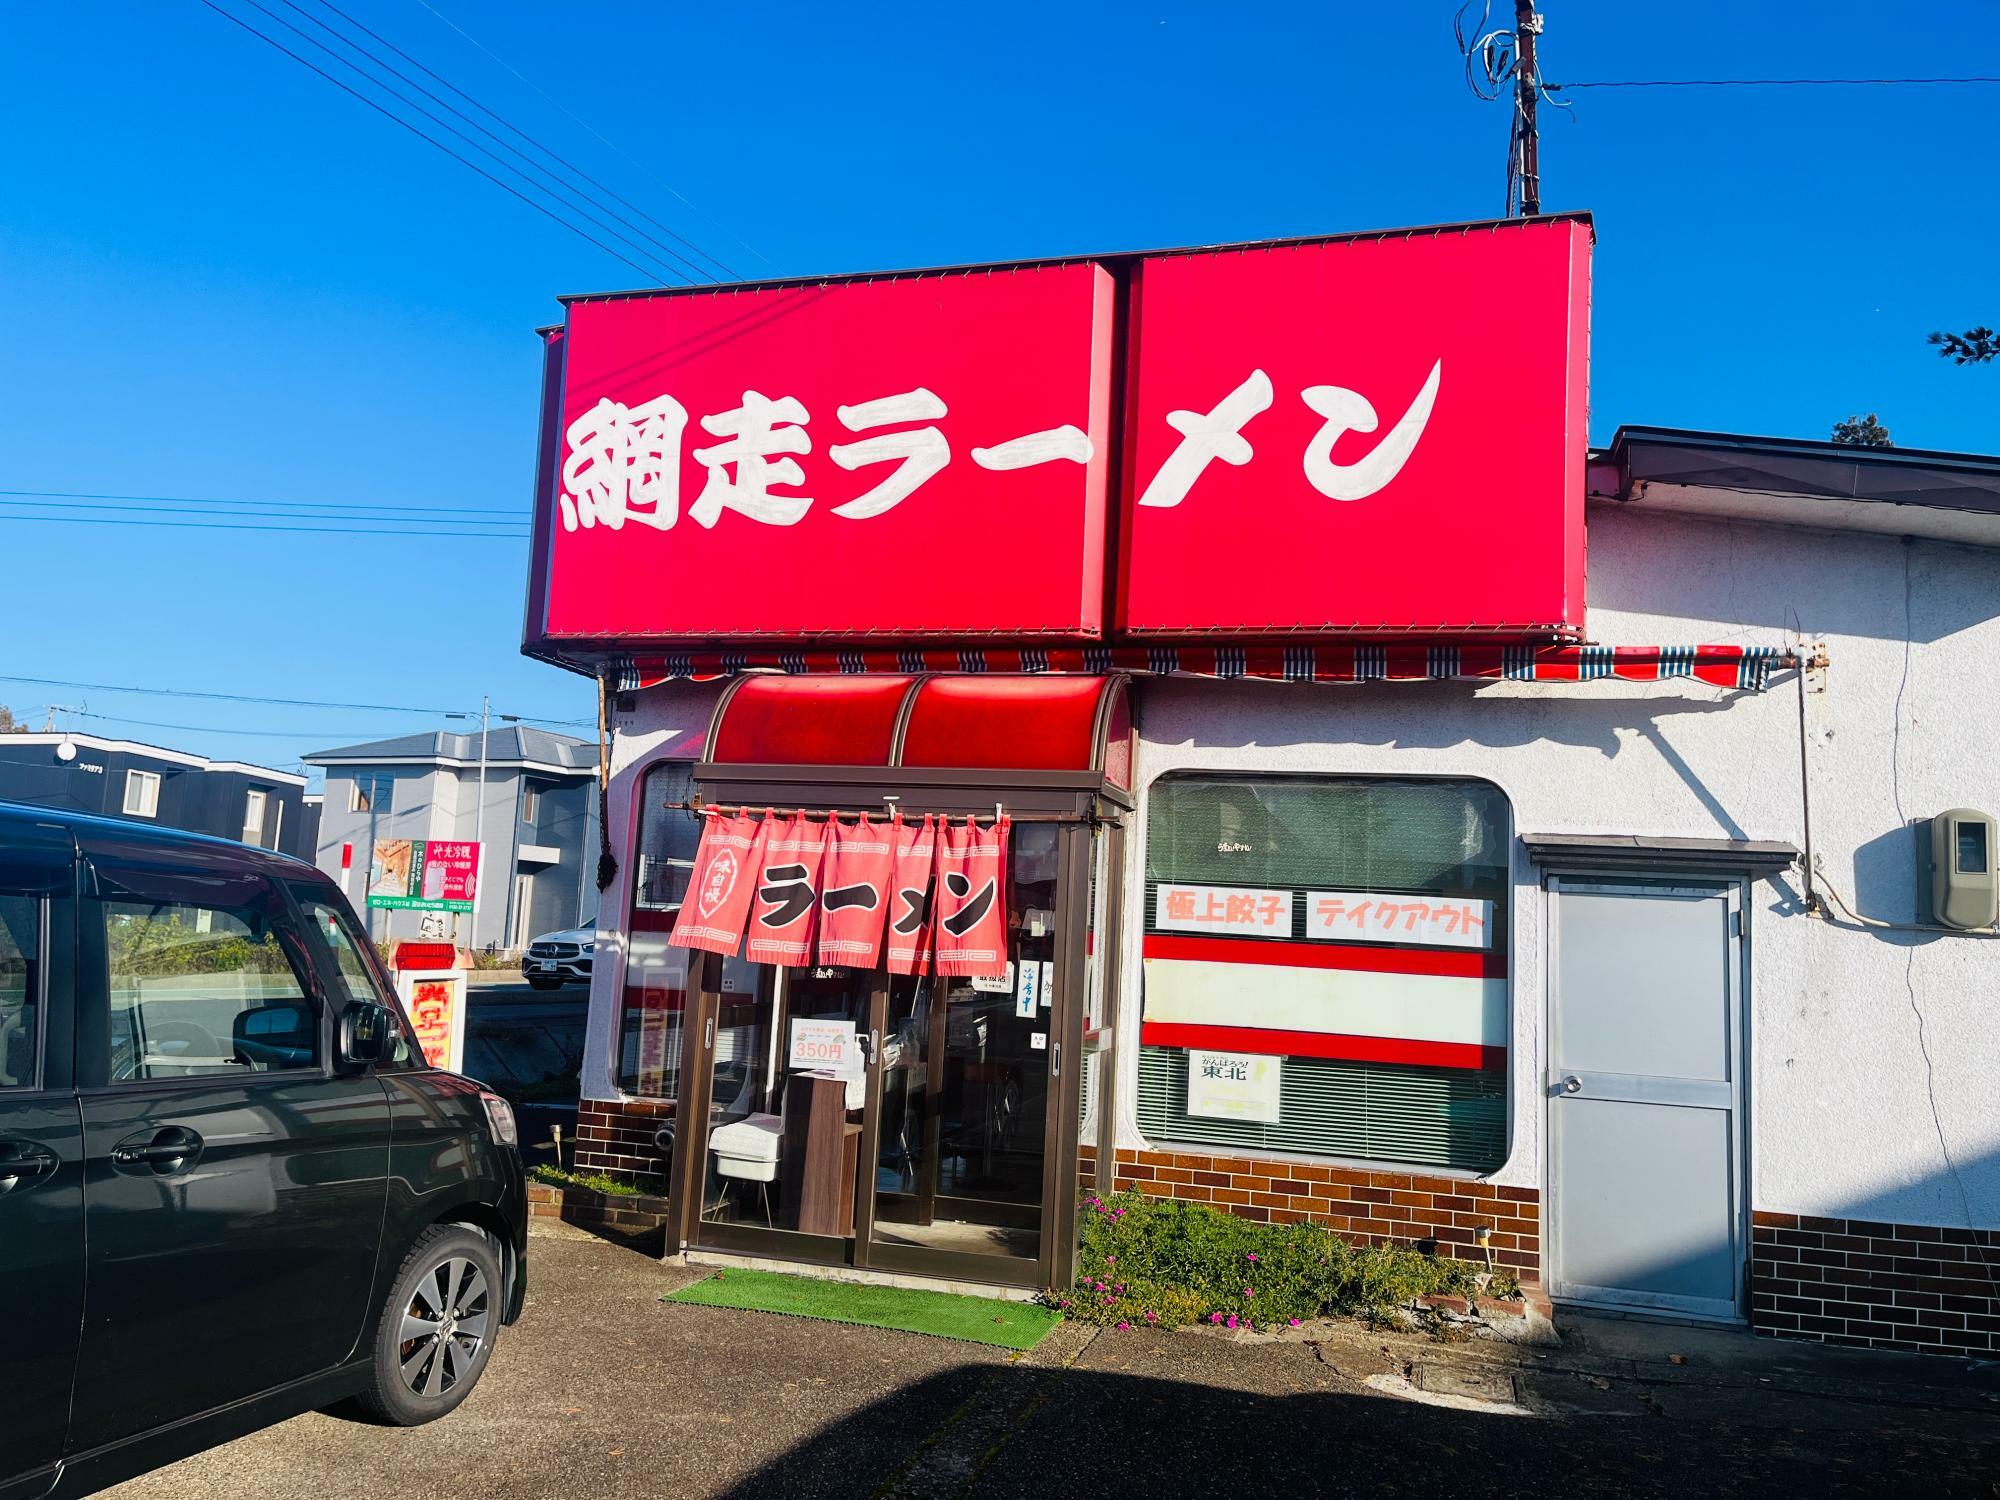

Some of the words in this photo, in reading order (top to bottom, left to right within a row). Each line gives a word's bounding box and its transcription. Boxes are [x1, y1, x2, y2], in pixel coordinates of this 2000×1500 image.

[560, 357, 1441, 532] 網走ラーメン
[705, 859, 731, 903] 味自慢
[759, 862, 995, 938] ラーメン
[1166, 890, 1285, 926] 極上餃子
[1316, 899, 1484, 935] テイクアウト
[796, 1042, 842, 1059] 350円
[1201, 1065, 1247, 1081] 東北
